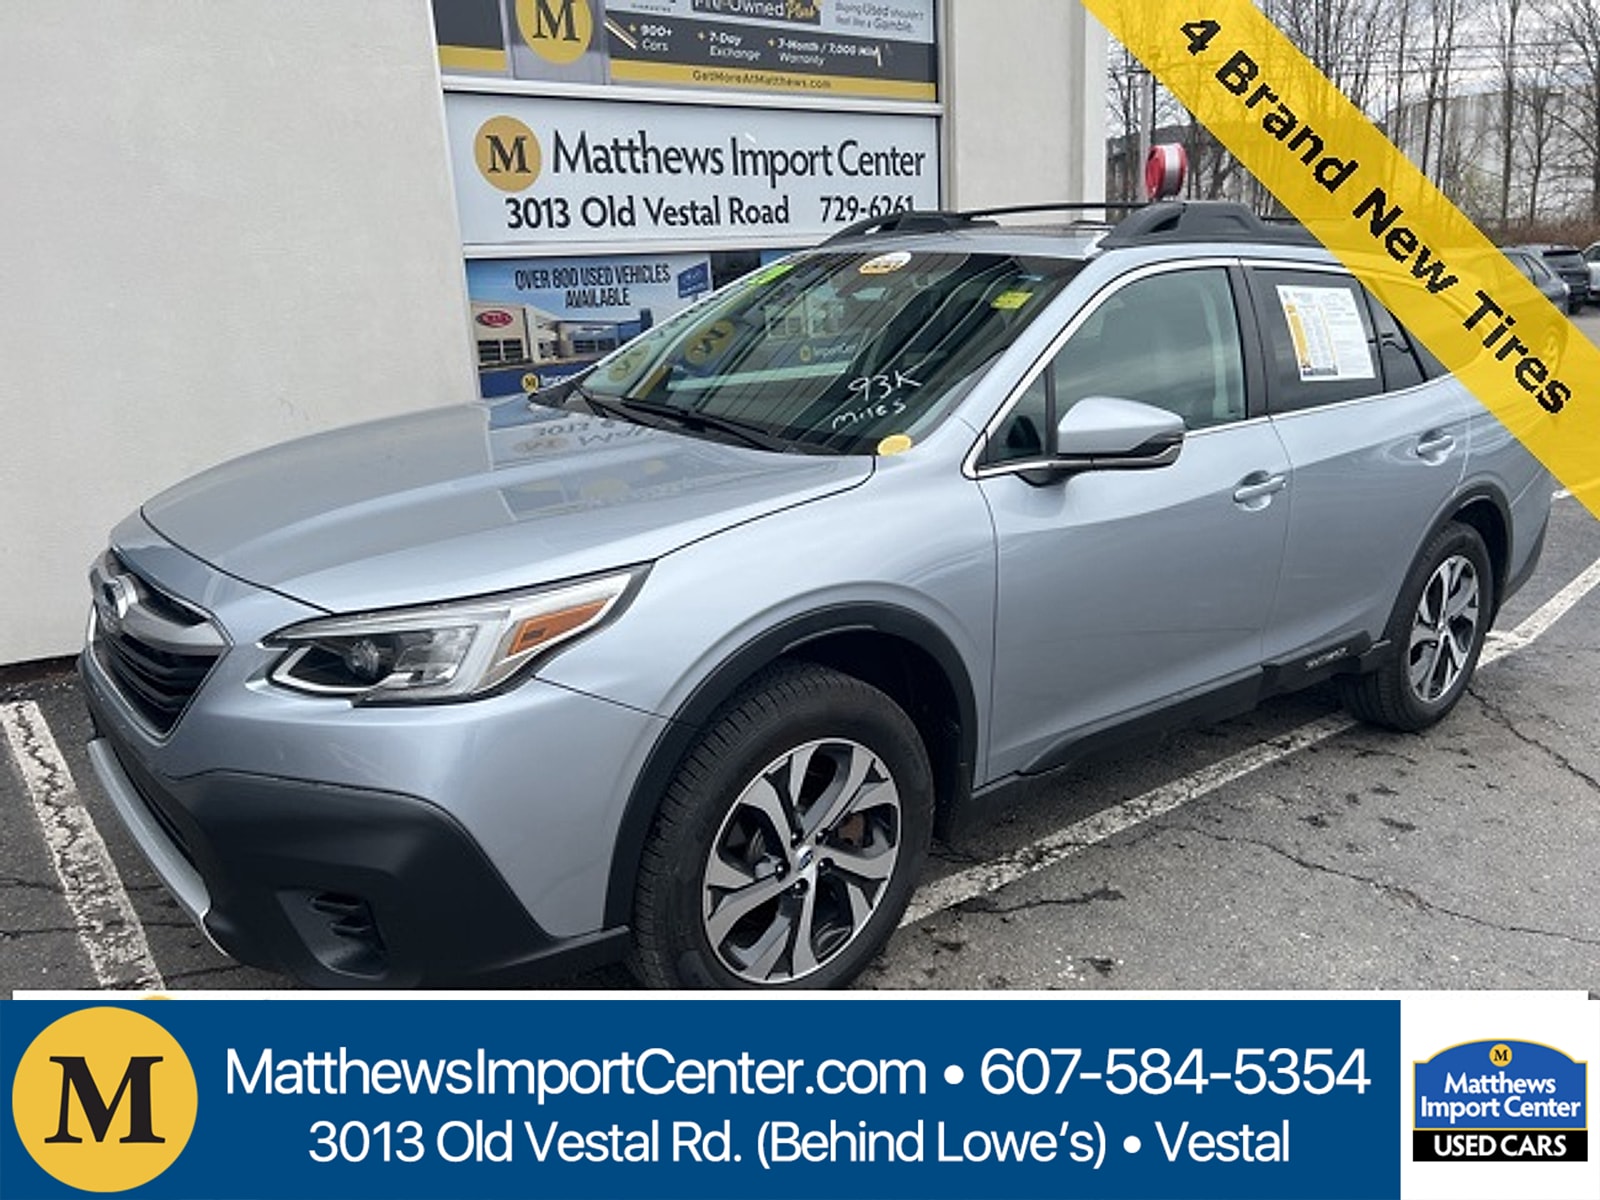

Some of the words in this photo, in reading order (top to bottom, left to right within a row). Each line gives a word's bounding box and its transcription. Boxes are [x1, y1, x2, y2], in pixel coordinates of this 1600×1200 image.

[533, 0, 581, 41] M
[641, 39, 669, 51] Cars
[710, 46, 761, 60] Exchange
[779, 52, 825, 66] Warranty
[486, 135, 531, 174] M
[553, 130, 723, 175] Matthews
[731, 137, 833, 189] Import
[838, 140, 926, 177] Center
[505, 198, 571, 229] 3013
[581, 195, 636, 227] Old
[644, 195, 721, 226] Vestal
[729, 195, 790, 224] Road
[515, 270, 550, 290] OVER
[553, 268, 578, 289] 800
[580, 266, 613, 285] USED
[616, 263, 671, 284] VEHICLES
[565, 288, 631, 309] AVAILABLE
[848, 370, 922, 401] 93K
